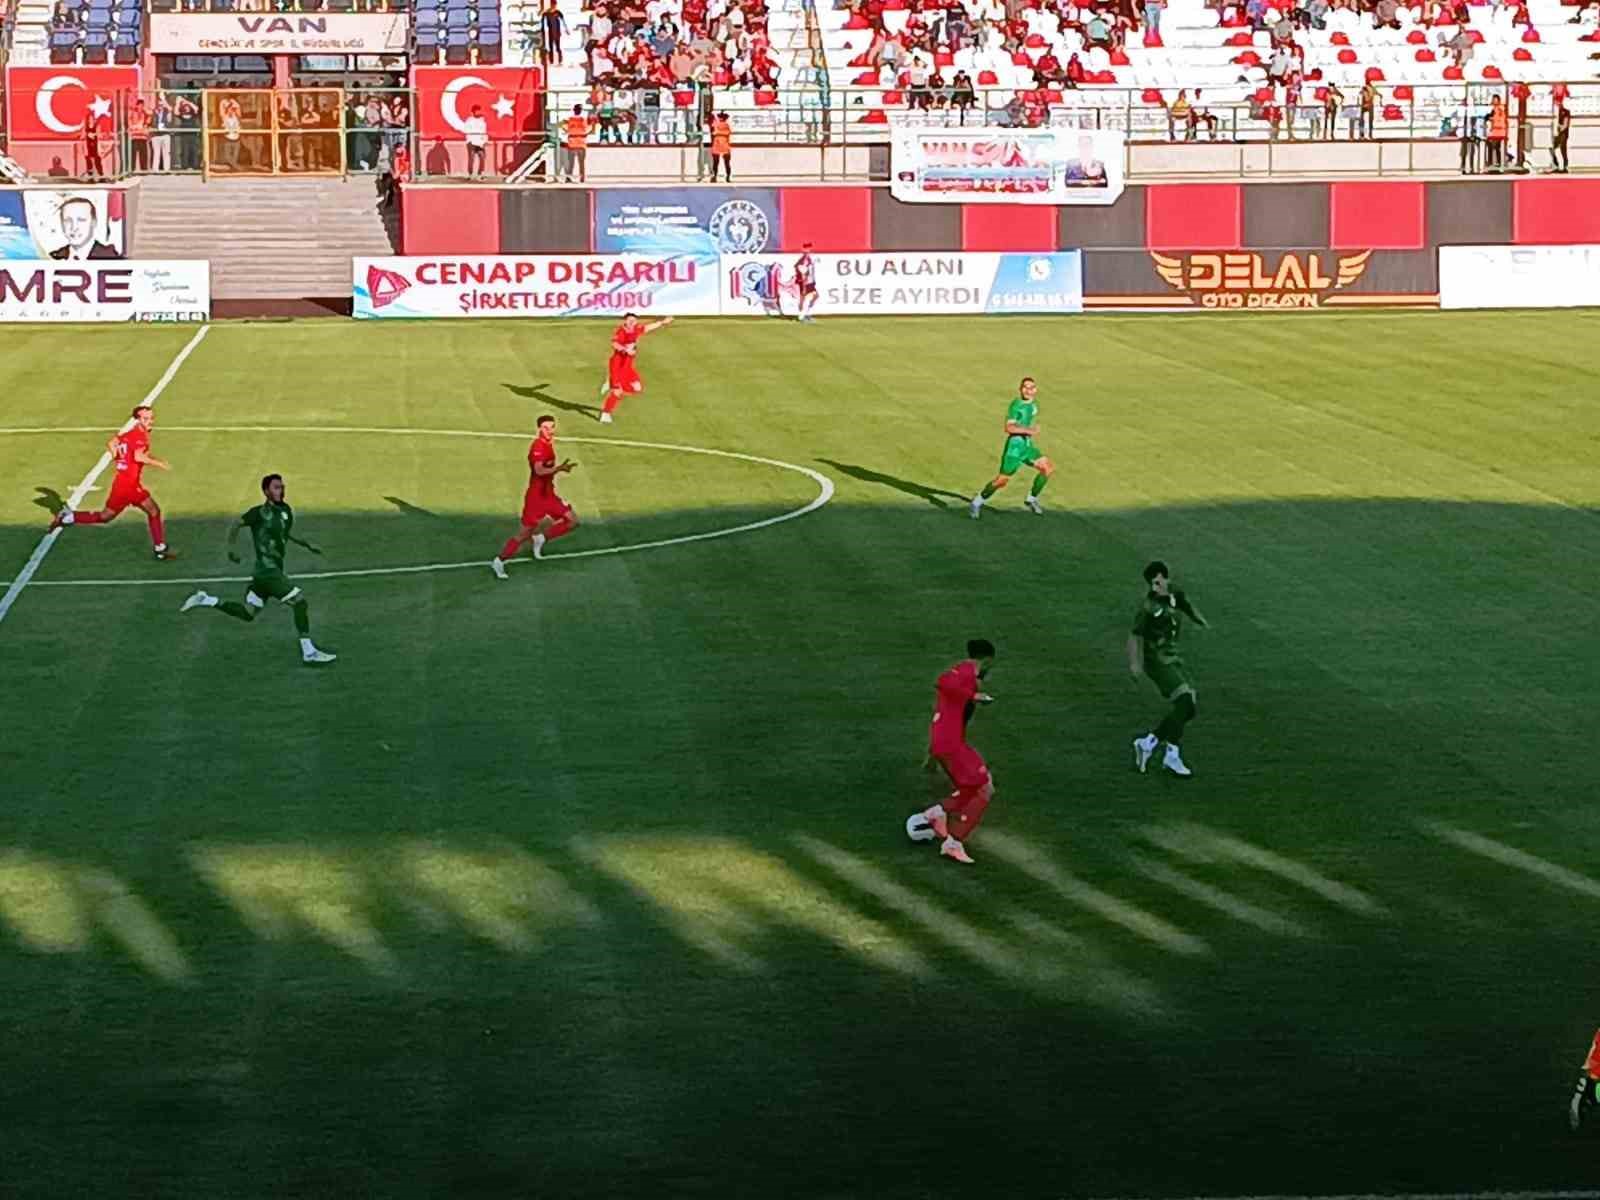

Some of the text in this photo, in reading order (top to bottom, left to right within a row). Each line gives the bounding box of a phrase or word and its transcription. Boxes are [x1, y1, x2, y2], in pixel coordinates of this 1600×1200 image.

[237, 17, 327, 33] VAN
[415, 261, 695, 288] CENAP DIŞARILI
[836, 258, 964, 277] BU ALANI
[1189, 254, 1332, 289] DELAL
[459, 289, 652, 313] ŞİRKETLER GRUBU
[827, 283, 882, 305] SİZE
[891, 286, 980, 304] AYIRDI
[1202, 294, 1243, 308] OTO
